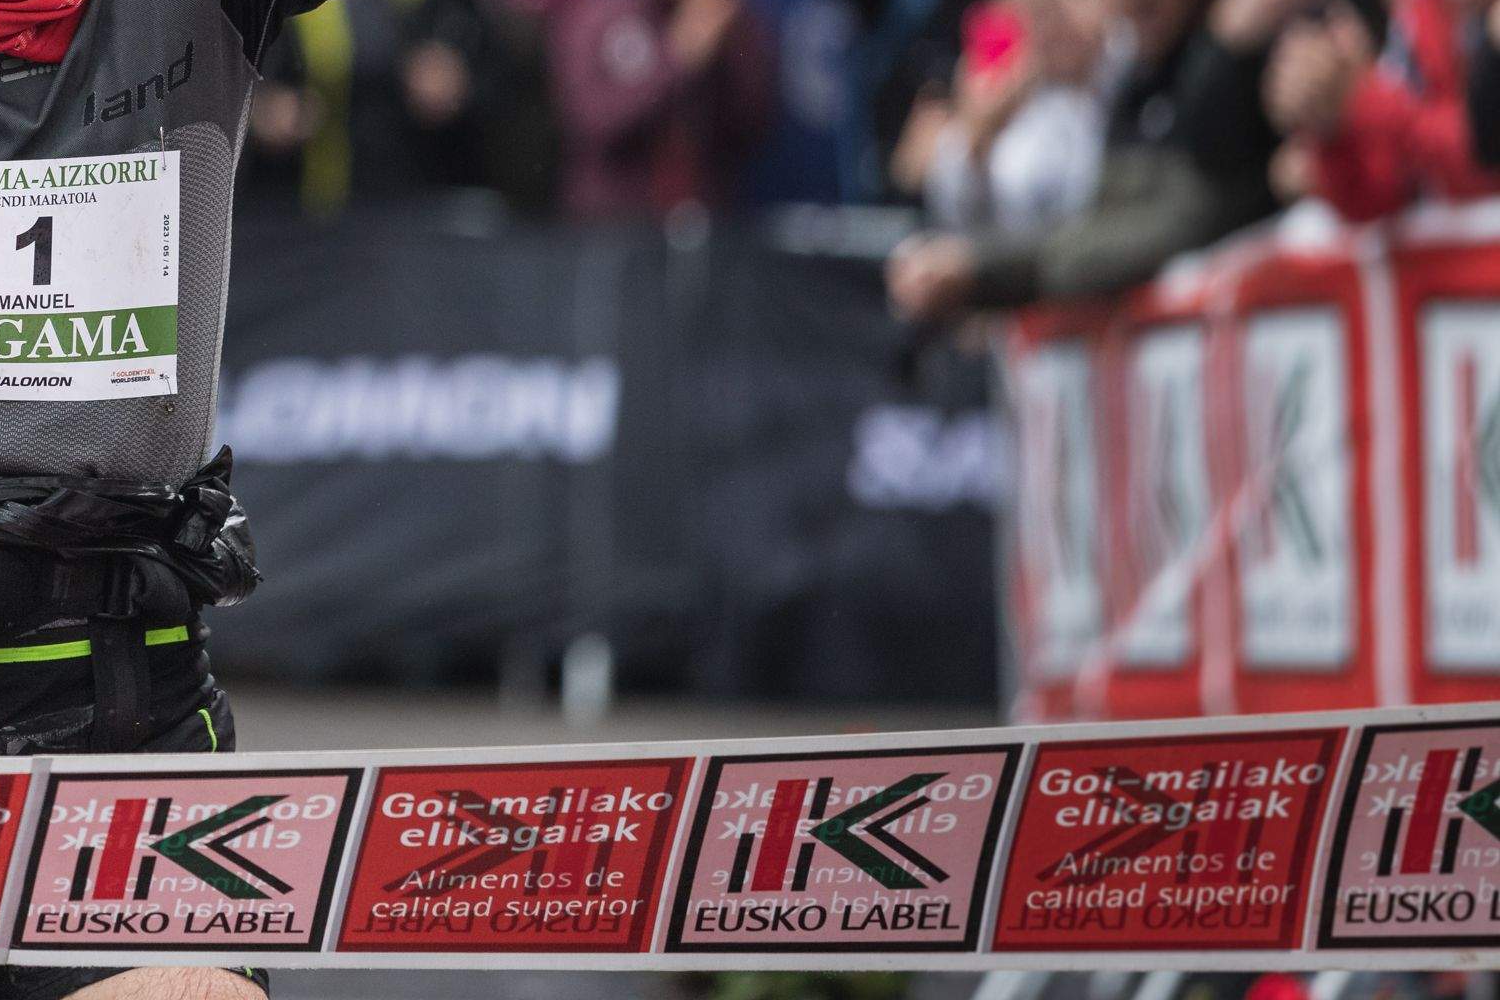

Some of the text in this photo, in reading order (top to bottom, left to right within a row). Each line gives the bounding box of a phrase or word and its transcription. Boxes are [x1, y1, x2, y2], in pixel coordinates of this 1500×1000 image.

[83, 39, 194, 127] land
[29, 191, 98, 206] MARATOIA
[15, 216, 54, 286] 1
[1038, 759, 1326, 797] Goi-mailako
[381, 786, 673, 819] Goi-mailako
[1055, 791, 1293, 831] elikagaiak
[400, 816, 641, 851] elikagaiak
[1055, 846, 1276, 877] Alimentos de
[400, 866, 625, 891] Alimentos de
[371, 895, 645, 922] calidad superior
[1026, 881, 1296, 912] calidad superior
[1345, 889, 1476, 925] EUSKO
[35, 910, 305, 934] EUSKO LABEL
[694, 902, 961, 932] EUSKO LABEL
